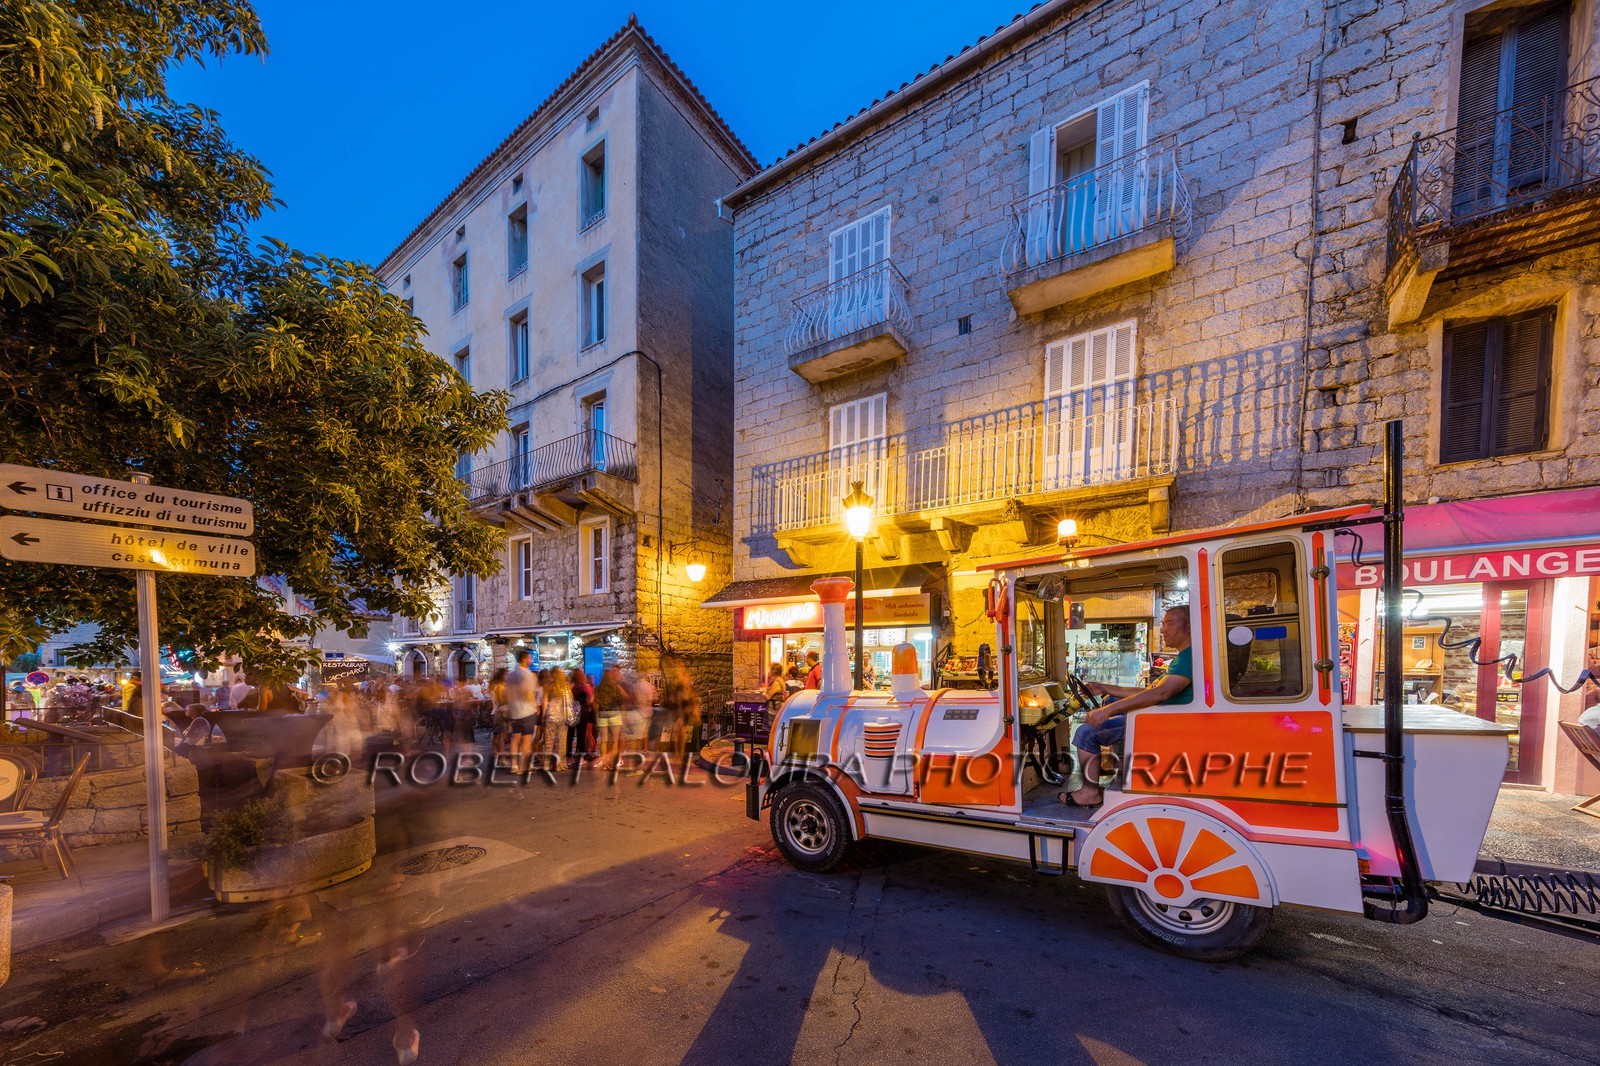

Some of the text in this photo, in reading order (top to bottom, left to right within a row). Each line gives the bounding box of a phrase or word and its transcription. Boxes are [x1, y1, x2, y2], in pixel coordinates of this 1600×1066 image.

[81, 483, 137, 500] office
[145, 492, 165, 505] du
[172, 495, 243, 514] tourisme
[82, 501, 248, 530] uffizziu di u turismu
[111, 533, 249, 556] hôtel de ville
[169, 557, 241, 570] cumuna
